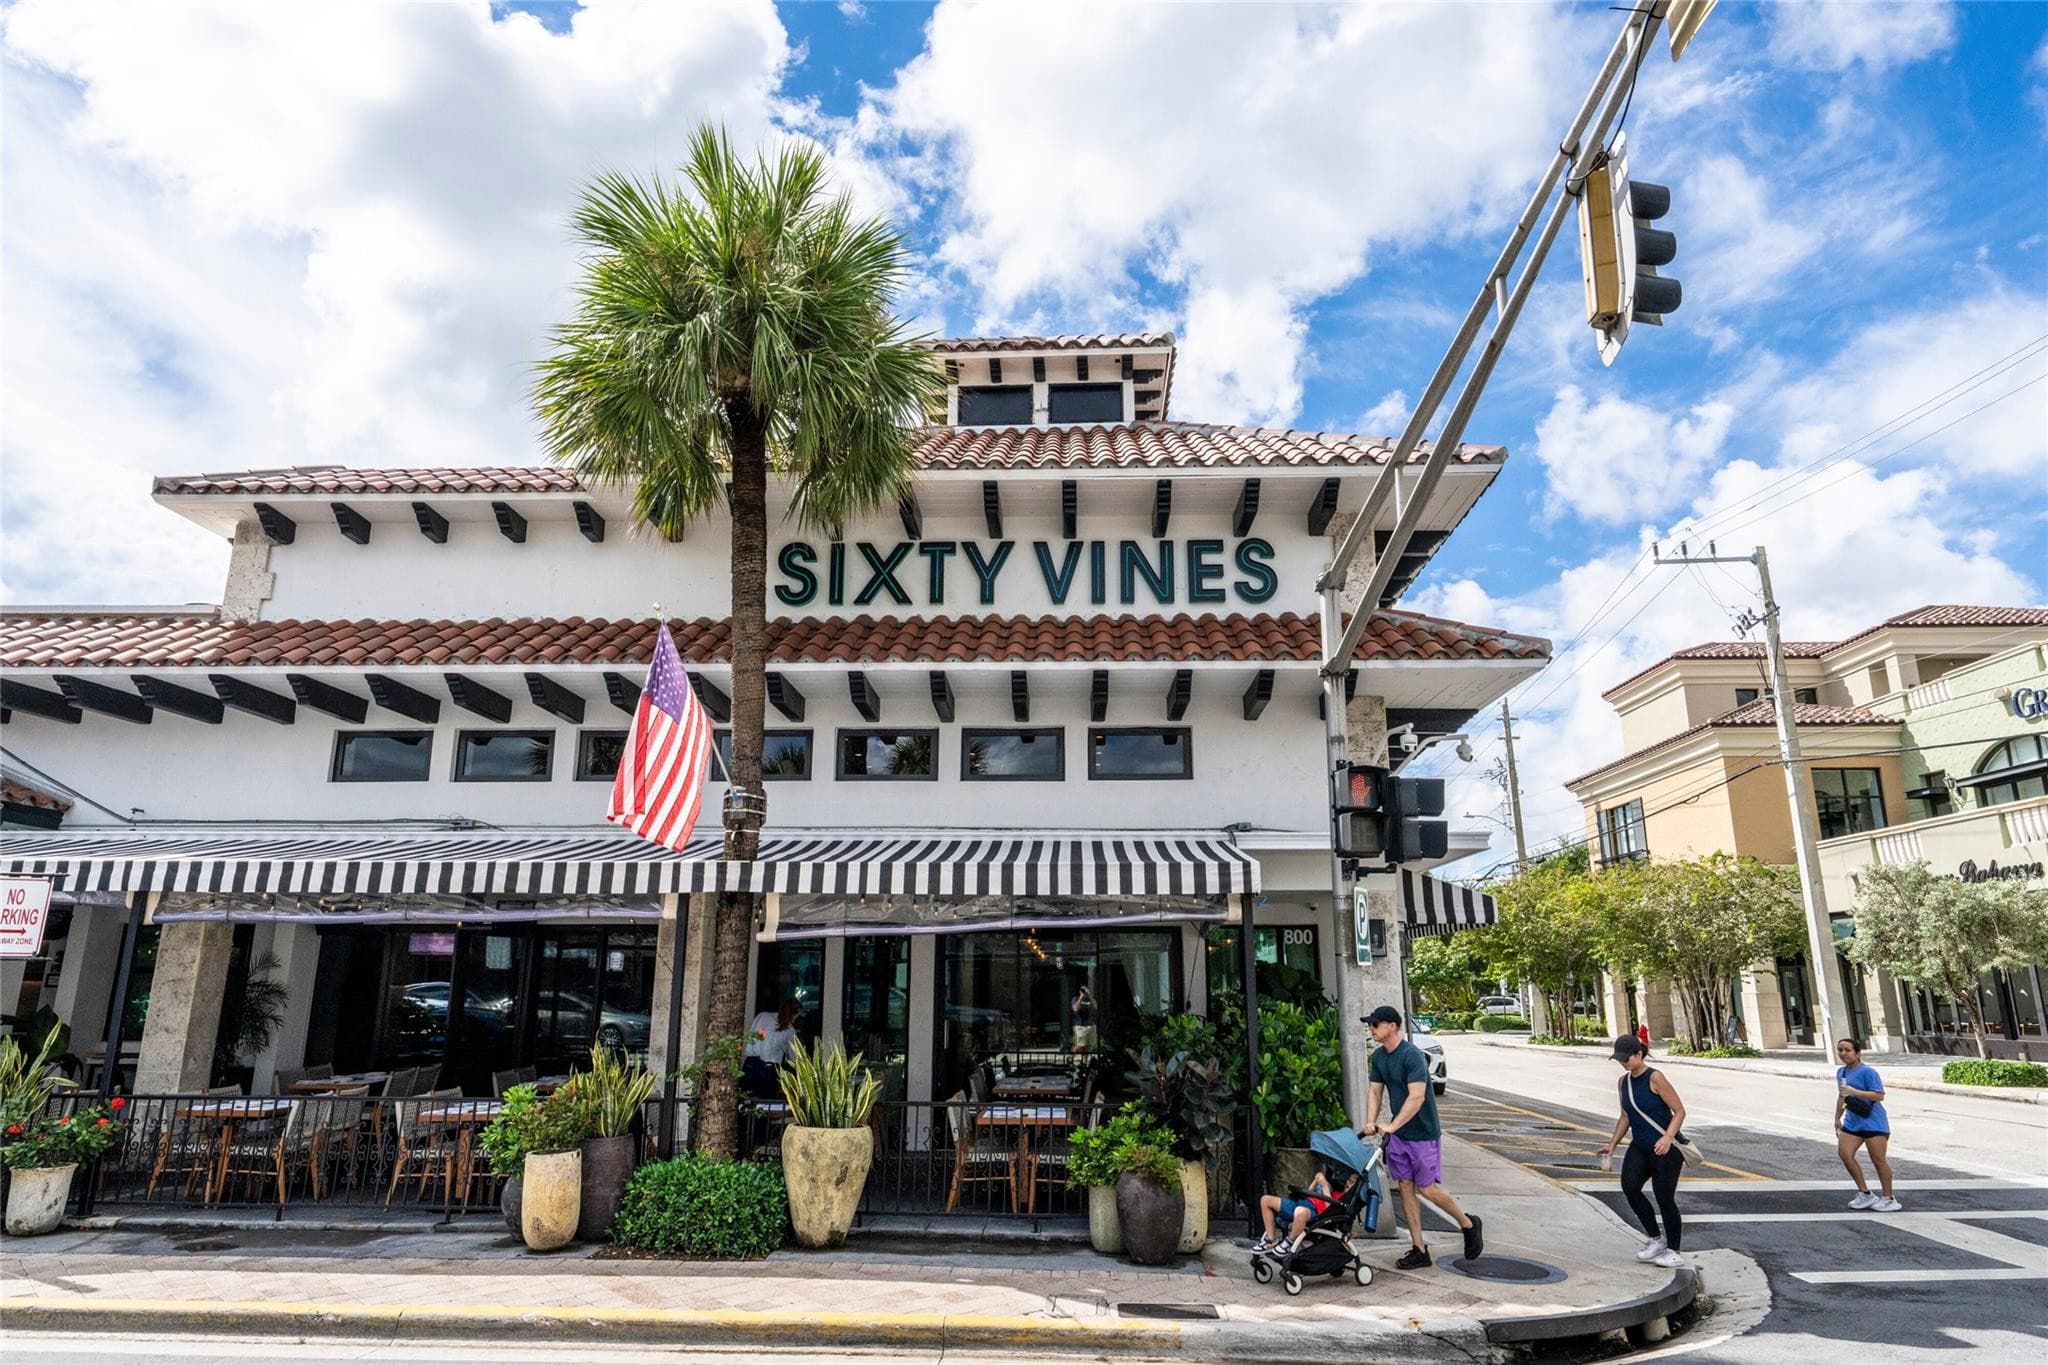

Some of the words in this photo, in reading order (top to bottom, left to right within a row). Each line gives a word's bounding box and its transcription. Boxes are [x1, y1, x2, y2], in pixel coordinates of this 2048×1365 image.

[774, 541, 1014, 606] SIXTY
[1033, 538, 1278, 605] VINES
[7, 888, 26, 905] NO
[1283, 929, 1313, 944] 800
